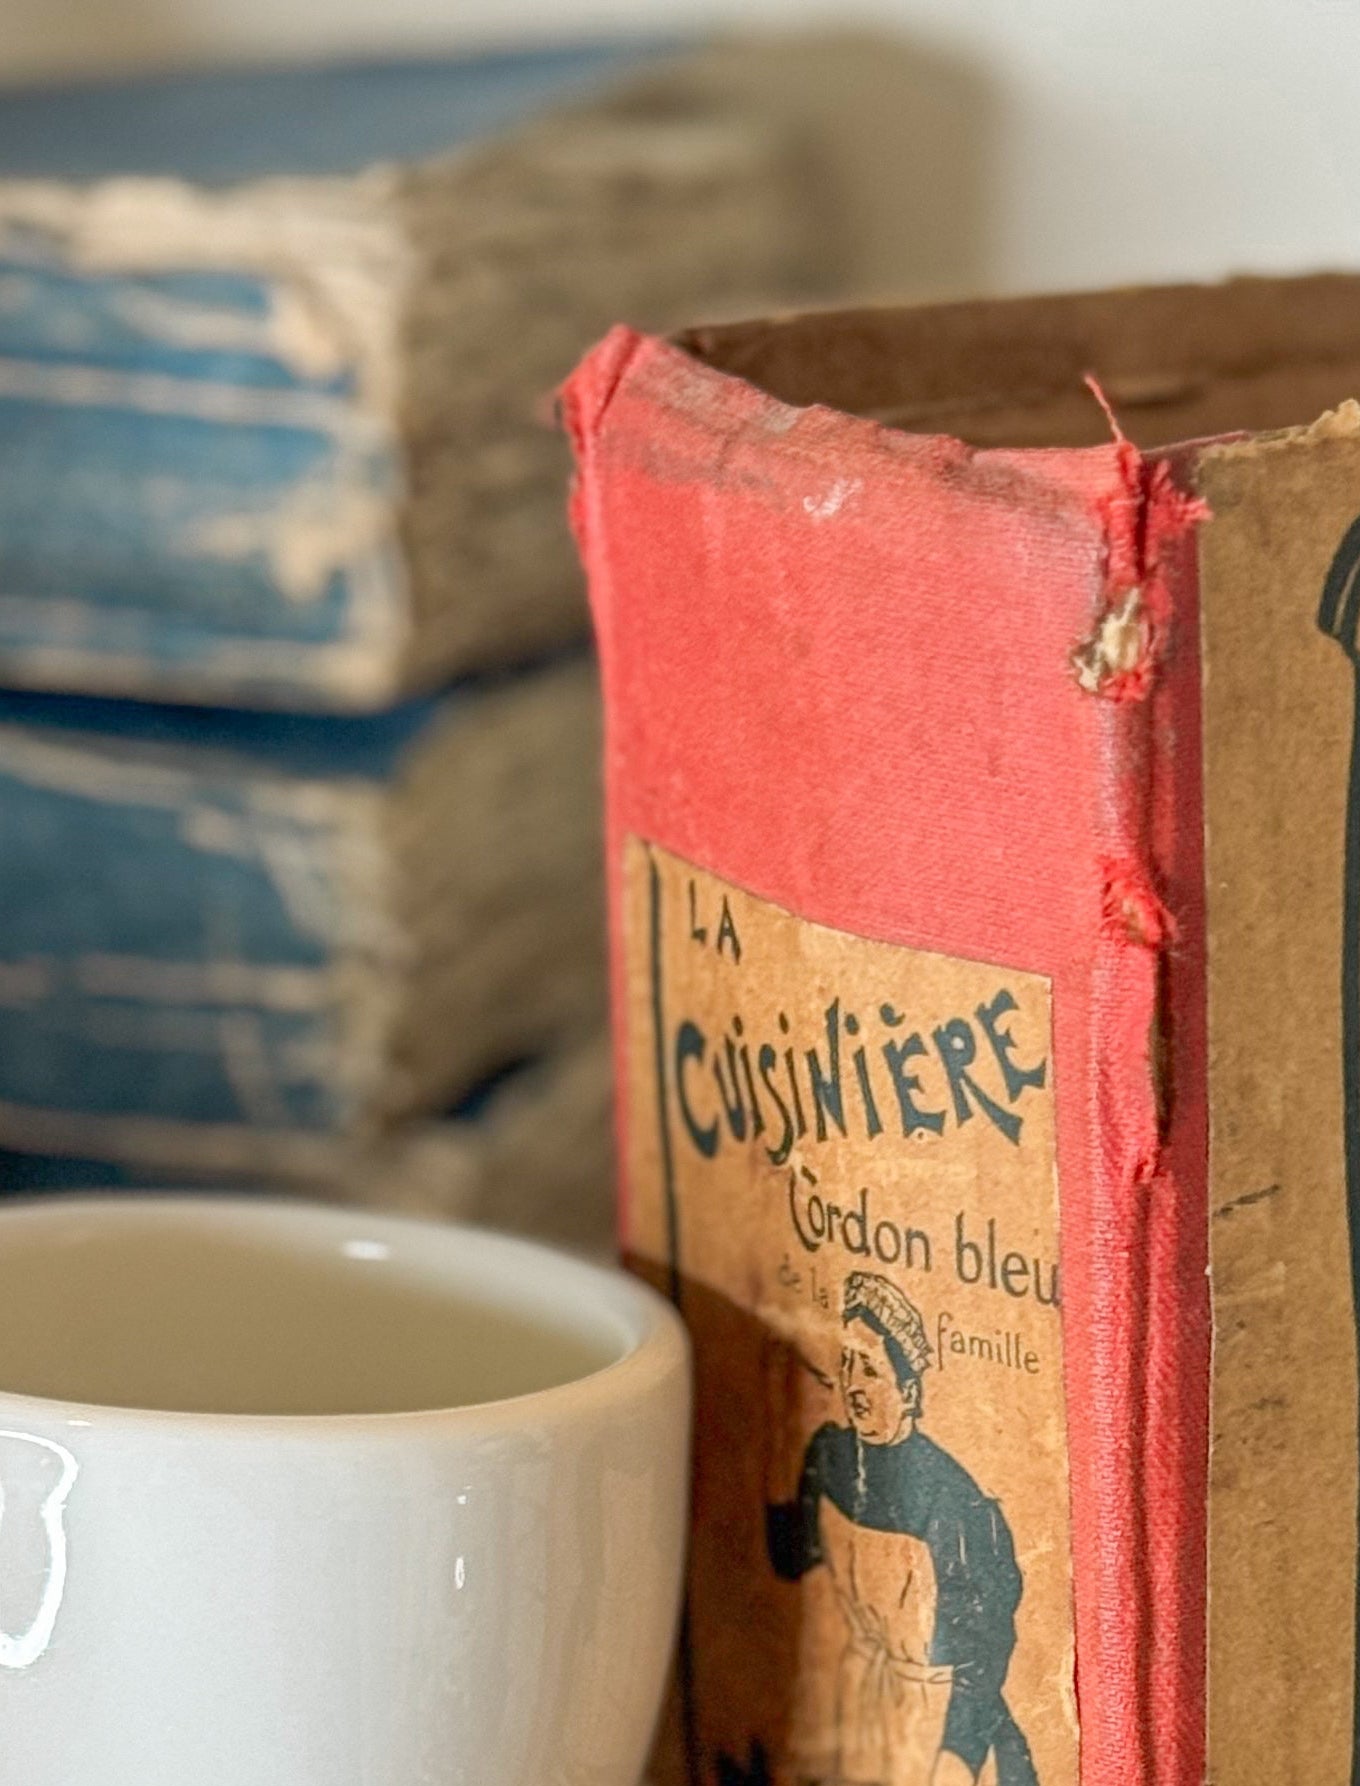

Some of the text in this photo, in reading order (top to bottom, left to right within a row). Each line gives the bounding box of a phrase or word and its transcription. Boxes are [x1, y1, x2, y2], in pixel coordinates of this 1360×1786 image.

[688, 879, 742, 965] LA
[788, 1164, 1061, 1309] Cordon bleu
[936, 1311, 1041, 1374] famille
